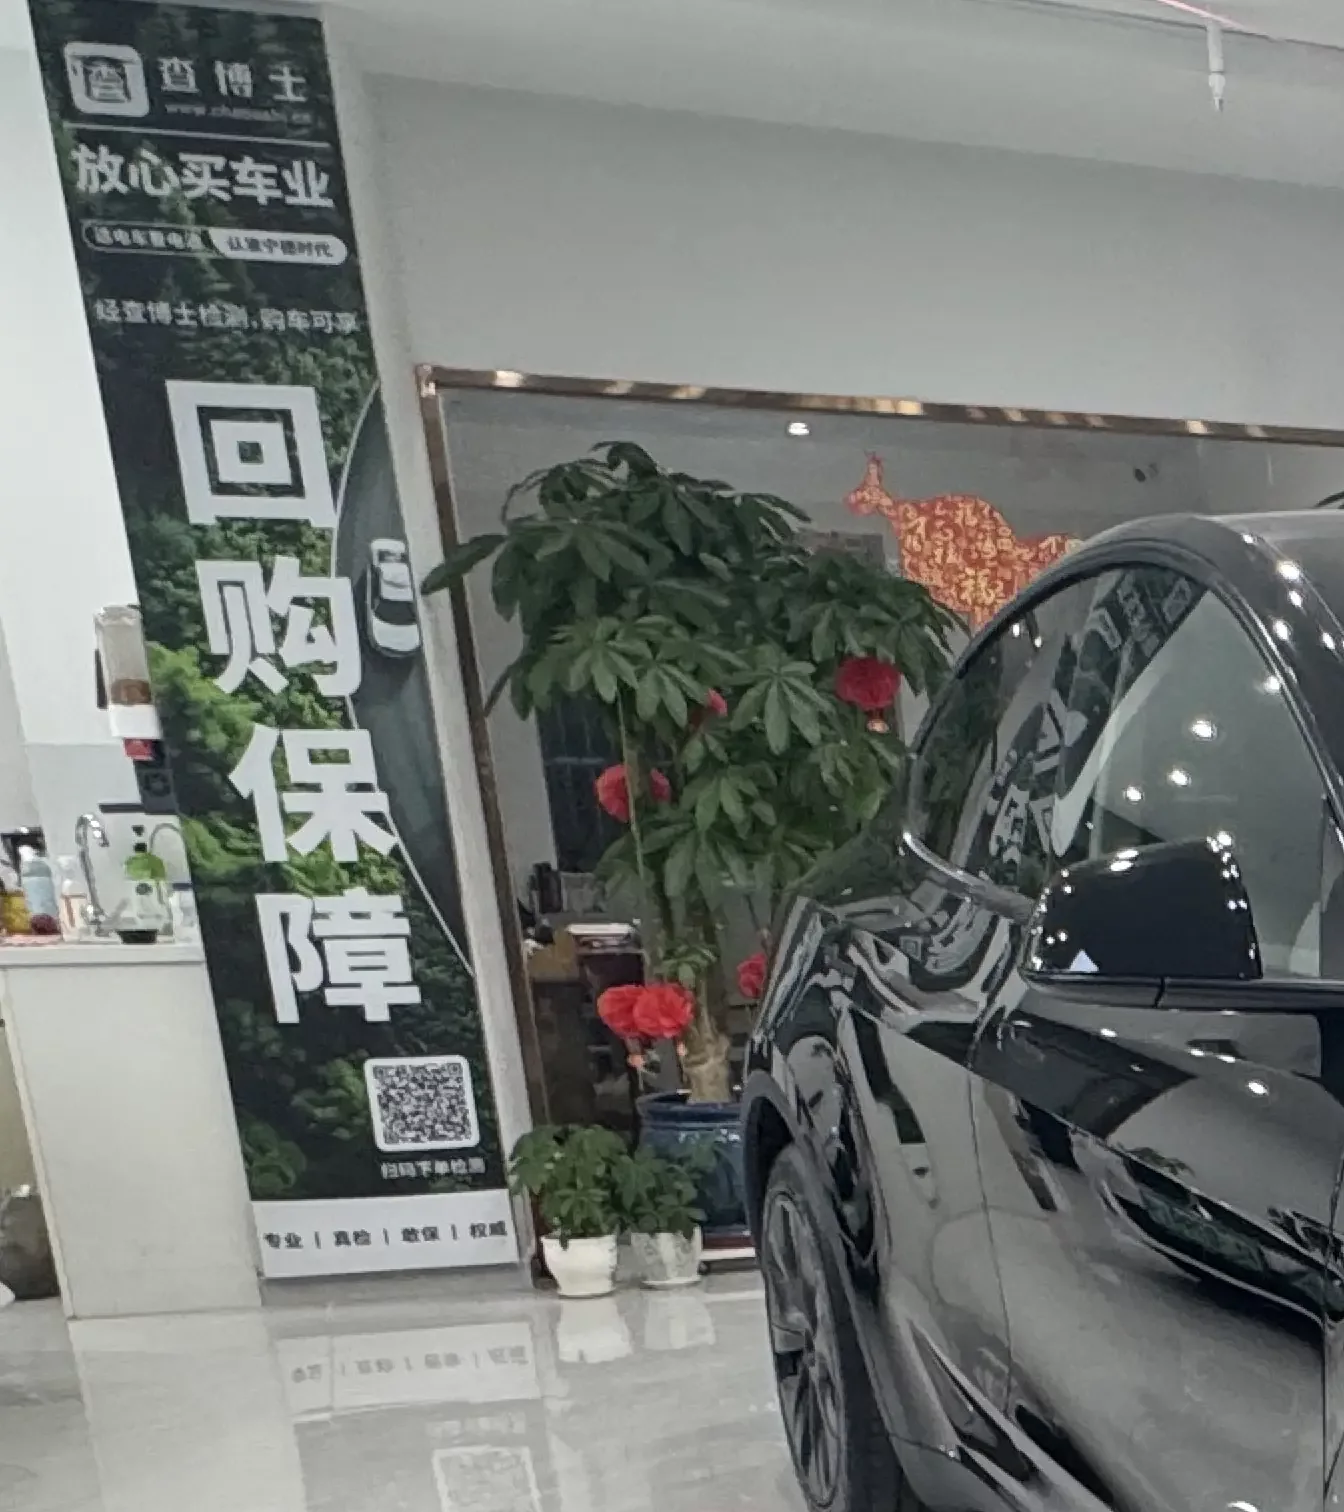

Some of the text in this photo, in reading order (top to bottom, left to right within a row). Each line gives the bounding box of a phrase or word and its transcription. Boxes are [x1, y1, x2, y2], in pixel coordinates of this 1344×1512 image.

[158, 56, 306, 103] 查博士
[72, 143, 334, 208] 放心买车业
[164, 379, 422, 1025] 回购保障
[263, 1231, 304, 1250] 专业
